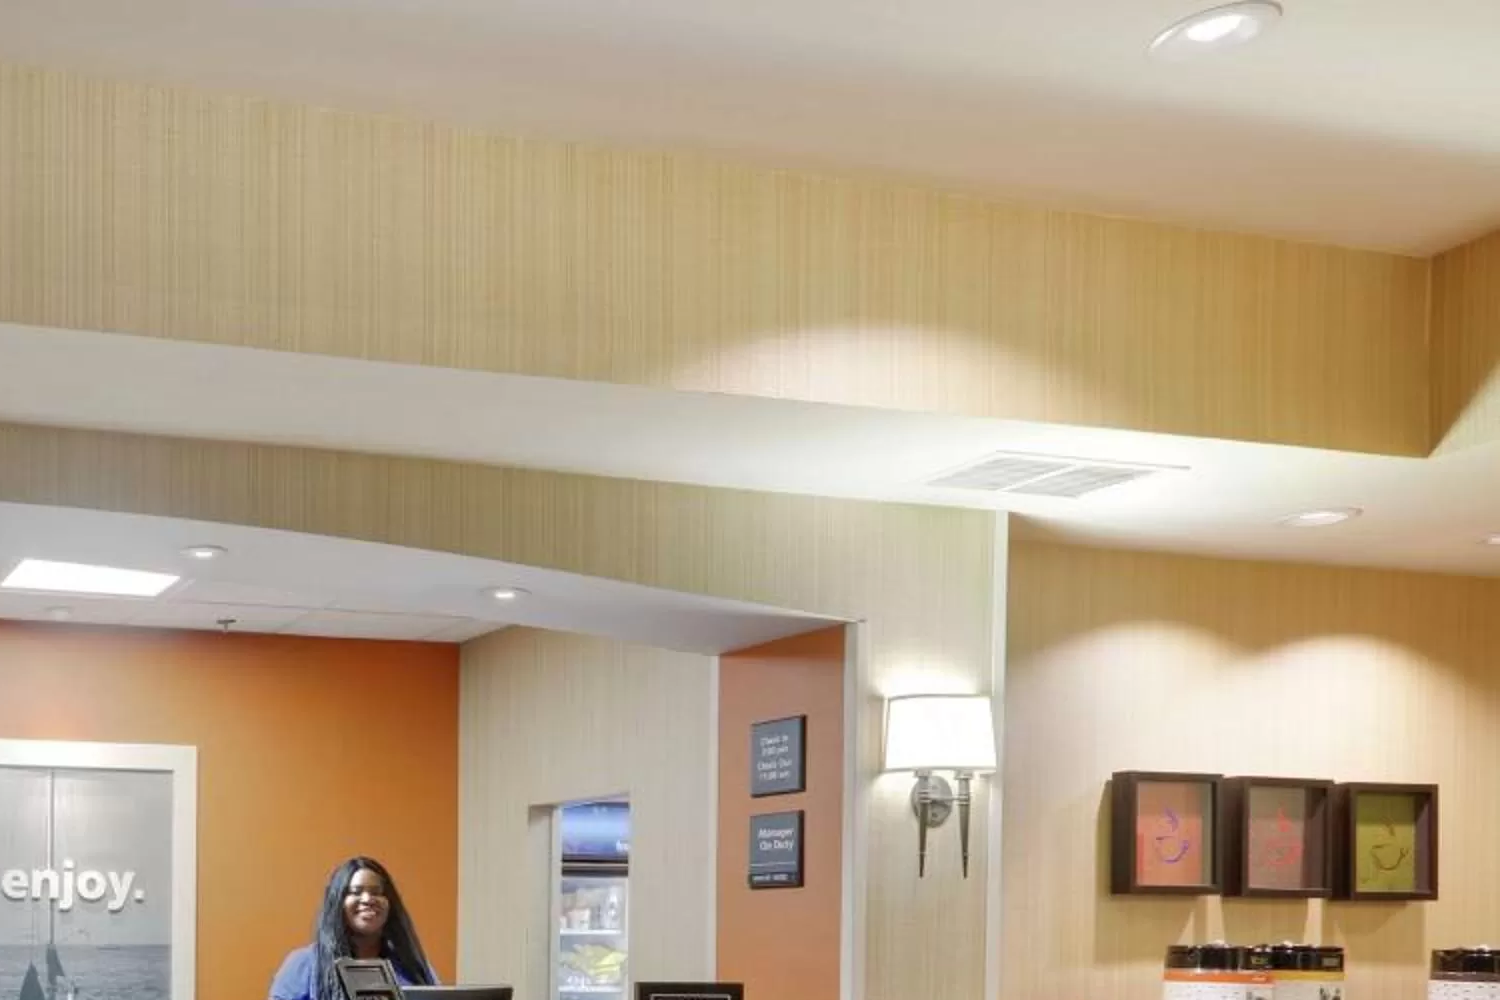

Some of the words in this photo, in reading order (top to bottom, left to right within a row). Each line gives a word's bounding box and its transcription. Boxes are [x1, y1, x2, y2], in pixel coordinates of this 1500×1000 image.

[757, 827, 795, 840] Manager
[773, 838, 795, 852] Duty
[1, 858, 145, 913] enjoy.
